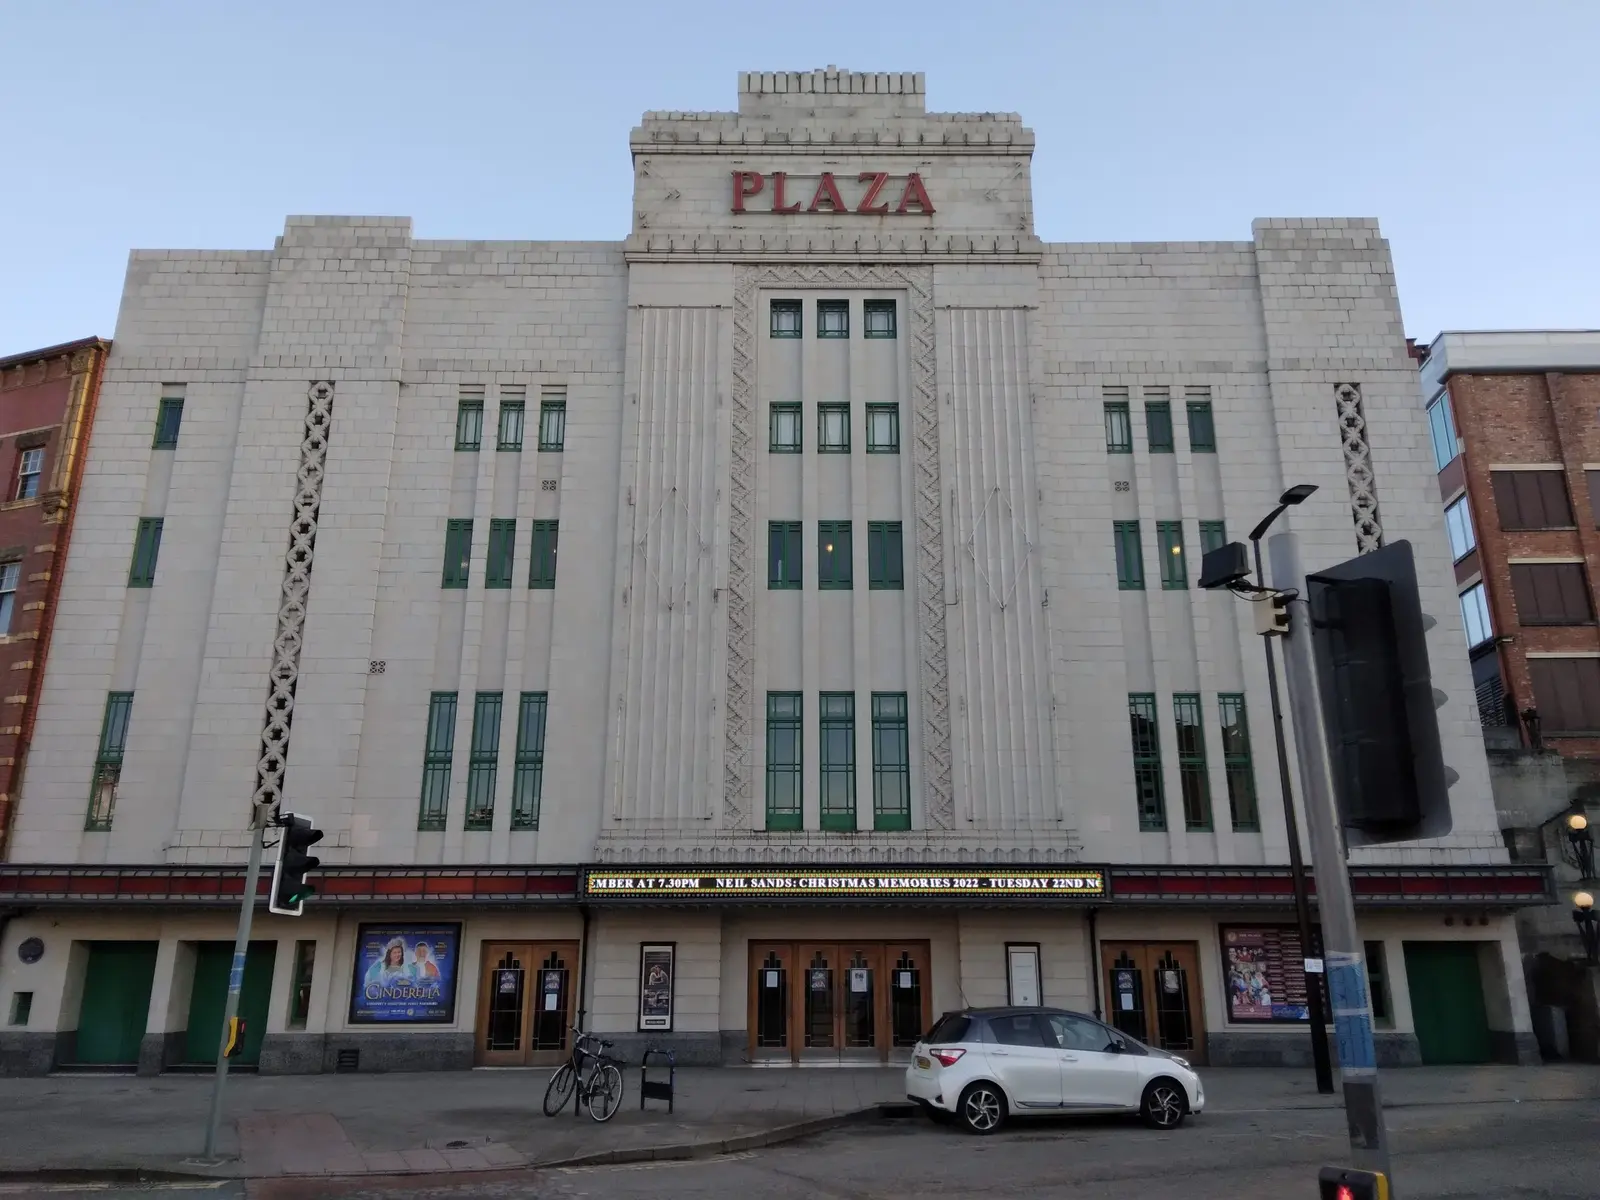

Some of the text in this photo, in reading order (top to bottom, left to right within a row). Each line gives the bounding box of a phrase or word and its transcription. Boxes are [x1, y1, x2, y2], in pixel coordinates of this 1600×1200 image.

[731, 172, 935, 213] PLAZA
[637, 878, 655, 889] AT
[658, 878, 700, 889] 7.30PM
[716, 878, 748, 889] NEIL
[750, 878, 797, 889] SANDS:
[799, 878, 876, 889] CHRISTMAS
[878, 878, 951, 889] MEMORIES
[953, 878, 979, 889] 2022
[989, 878, 1049, 889] TUESDAY
[1052, 878, 1084, 889] 22ND
[366, 983, 441, 1000] CINDERELLA
